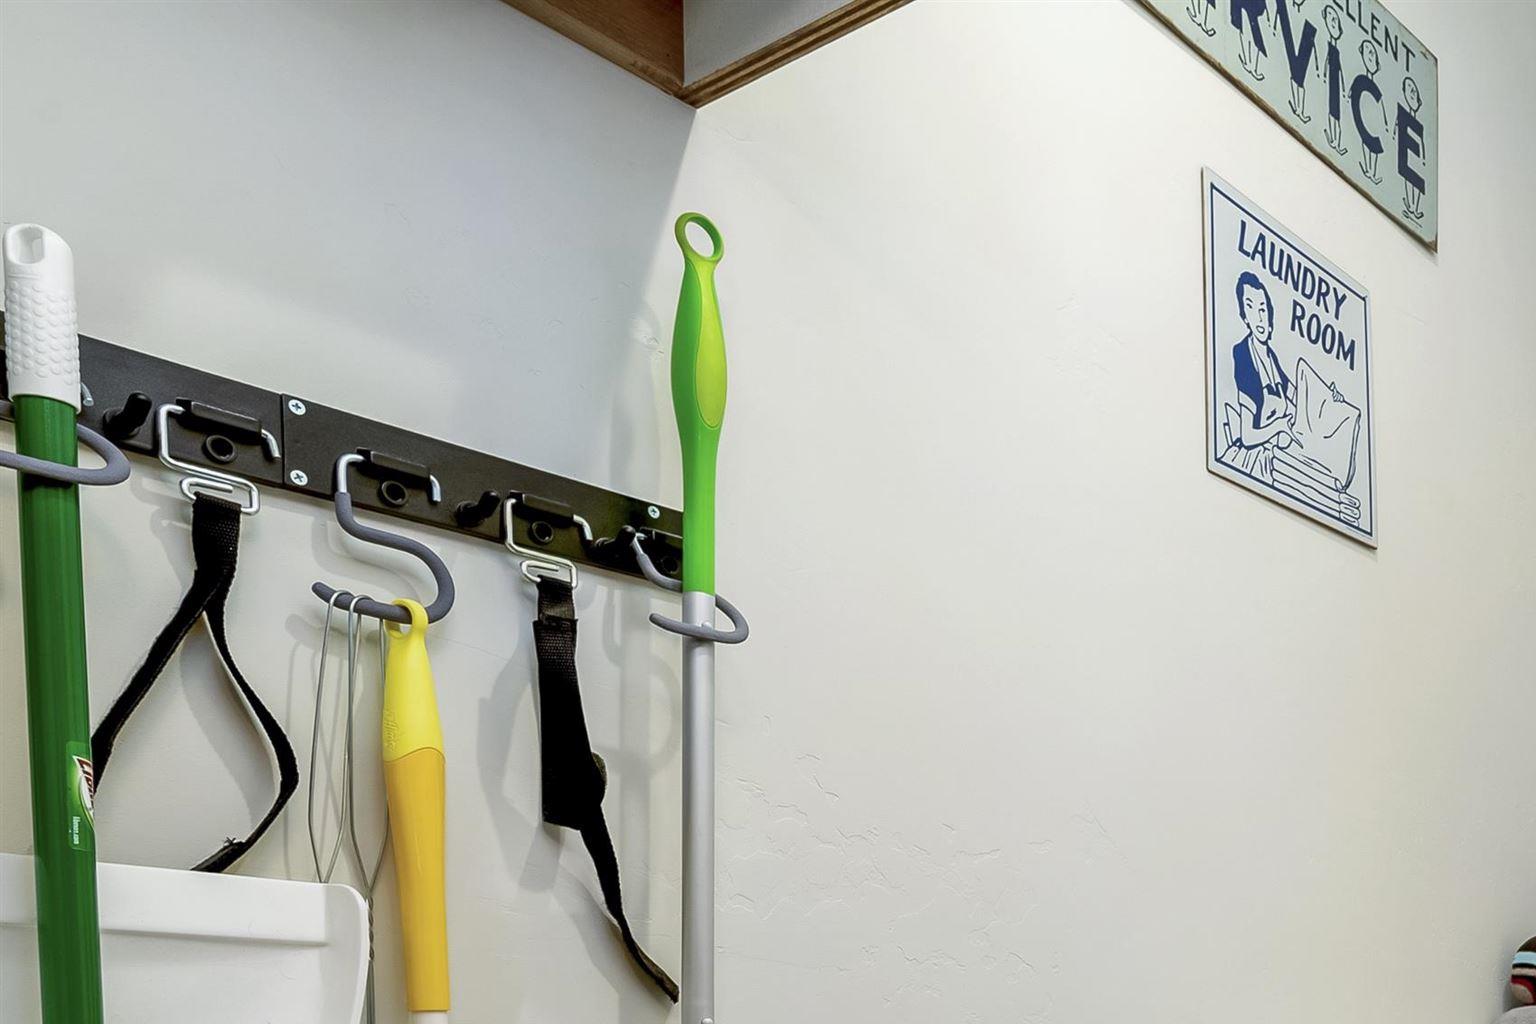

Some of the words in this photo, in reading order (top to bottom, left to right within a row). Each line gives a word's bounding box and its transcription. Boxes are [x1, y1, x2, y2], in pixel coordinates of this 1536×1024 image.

[1332, 0, 1415, 72] LLENT
[1228, 0, 1426, 196] RVICE
[1238, 219, 1347, 321] LAUNDRY
[1289, 299, 1356, 371] ROOM
